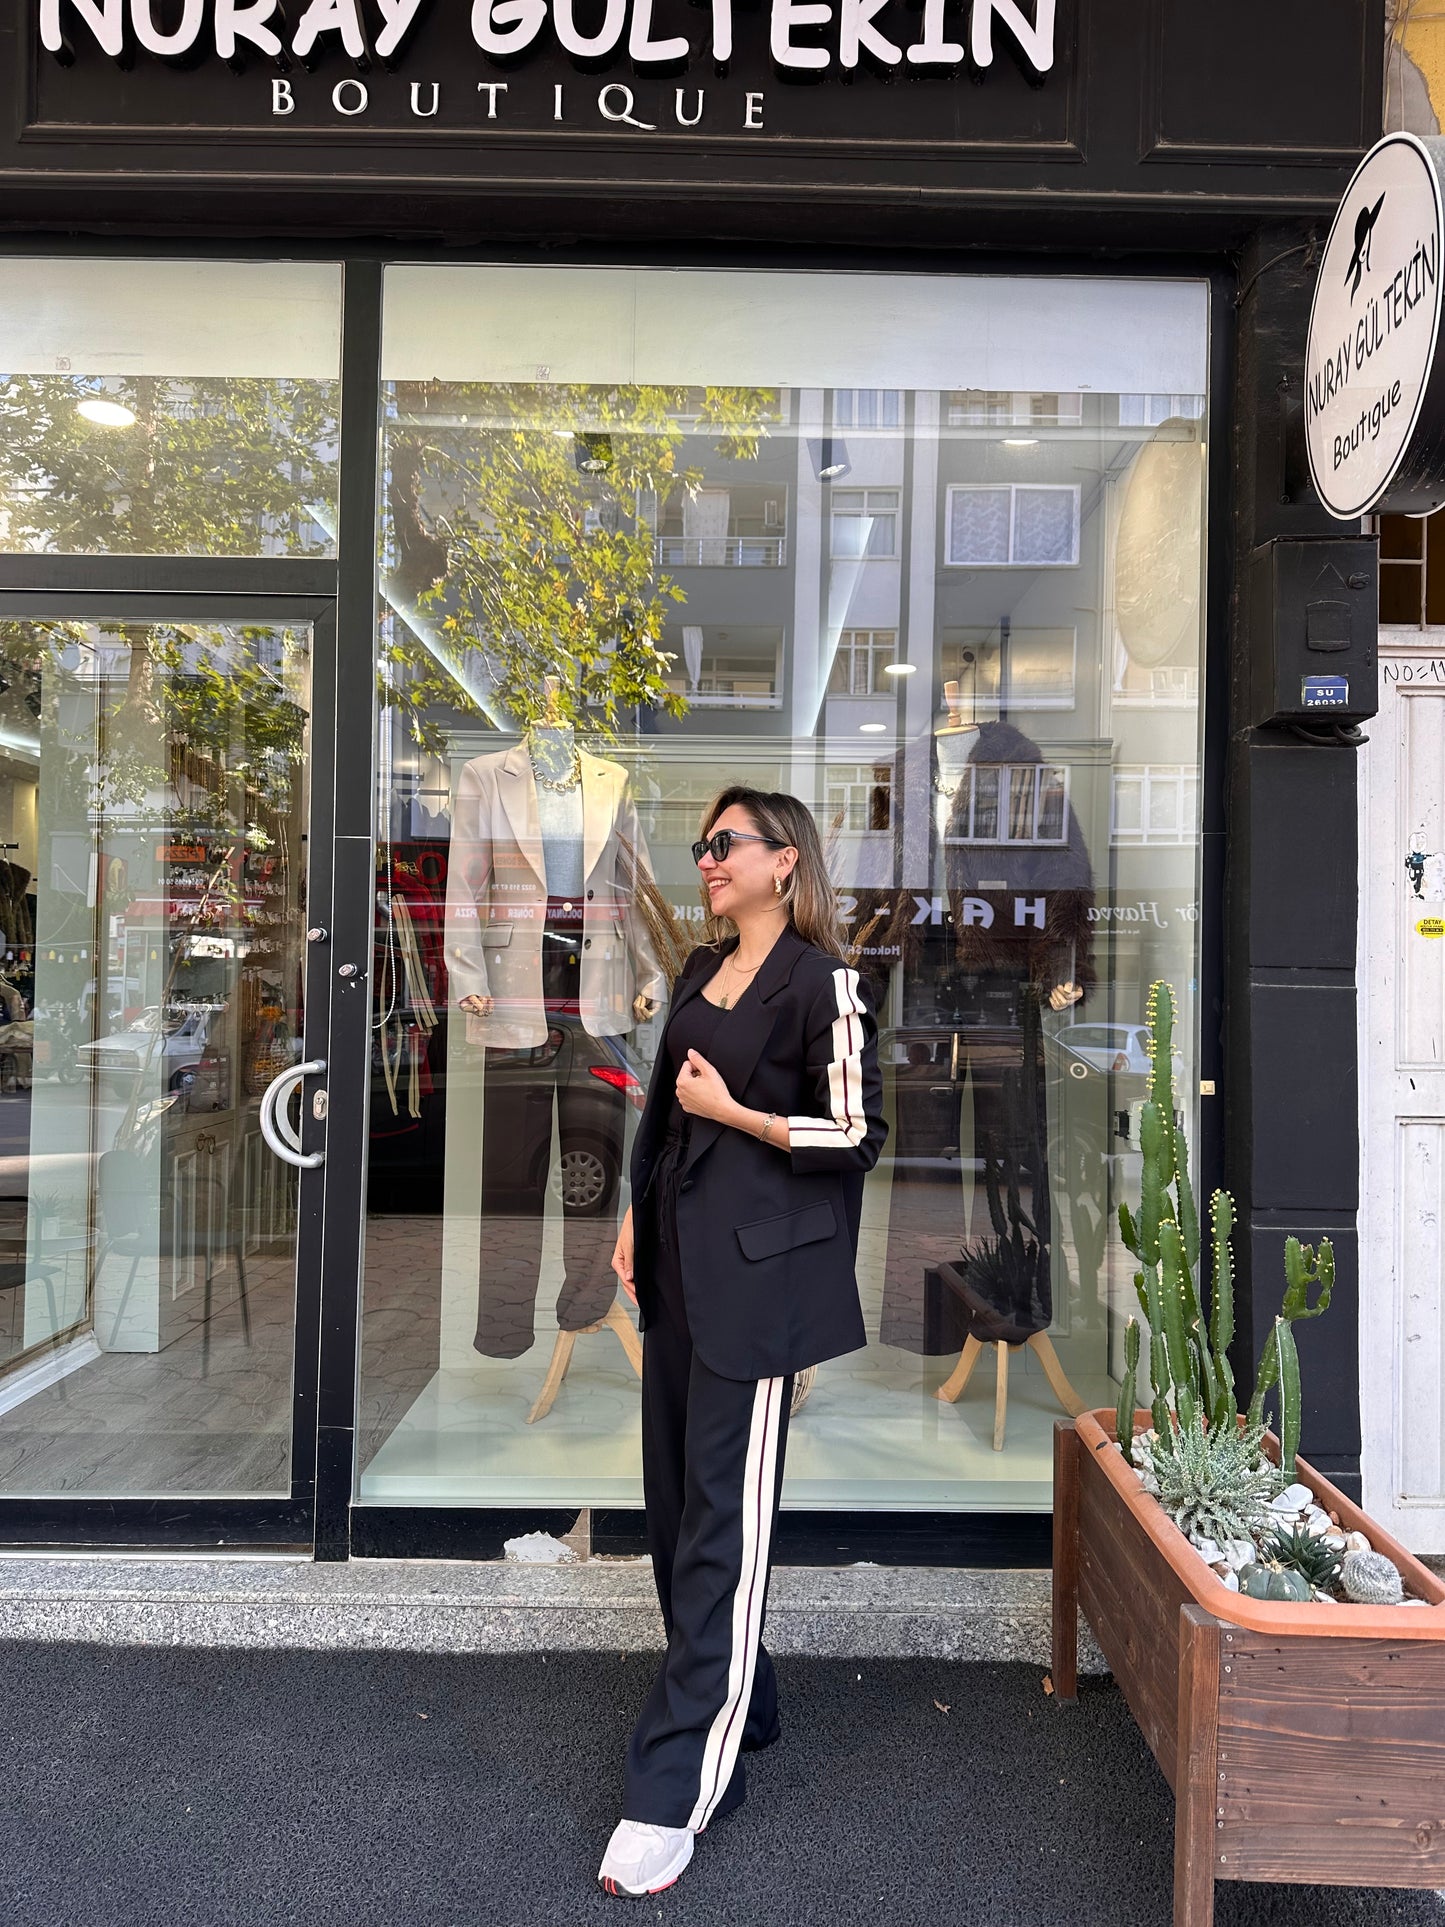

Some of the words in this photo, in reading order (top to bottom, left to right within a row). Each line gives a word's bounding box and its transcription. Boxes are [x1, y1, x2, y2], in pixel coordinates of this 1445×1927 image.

[271, 78, 764, 131] BOUTIQUE
[1308, 332, 1352, 424] NURAY
[1316, 689, 1334, 697] SU
